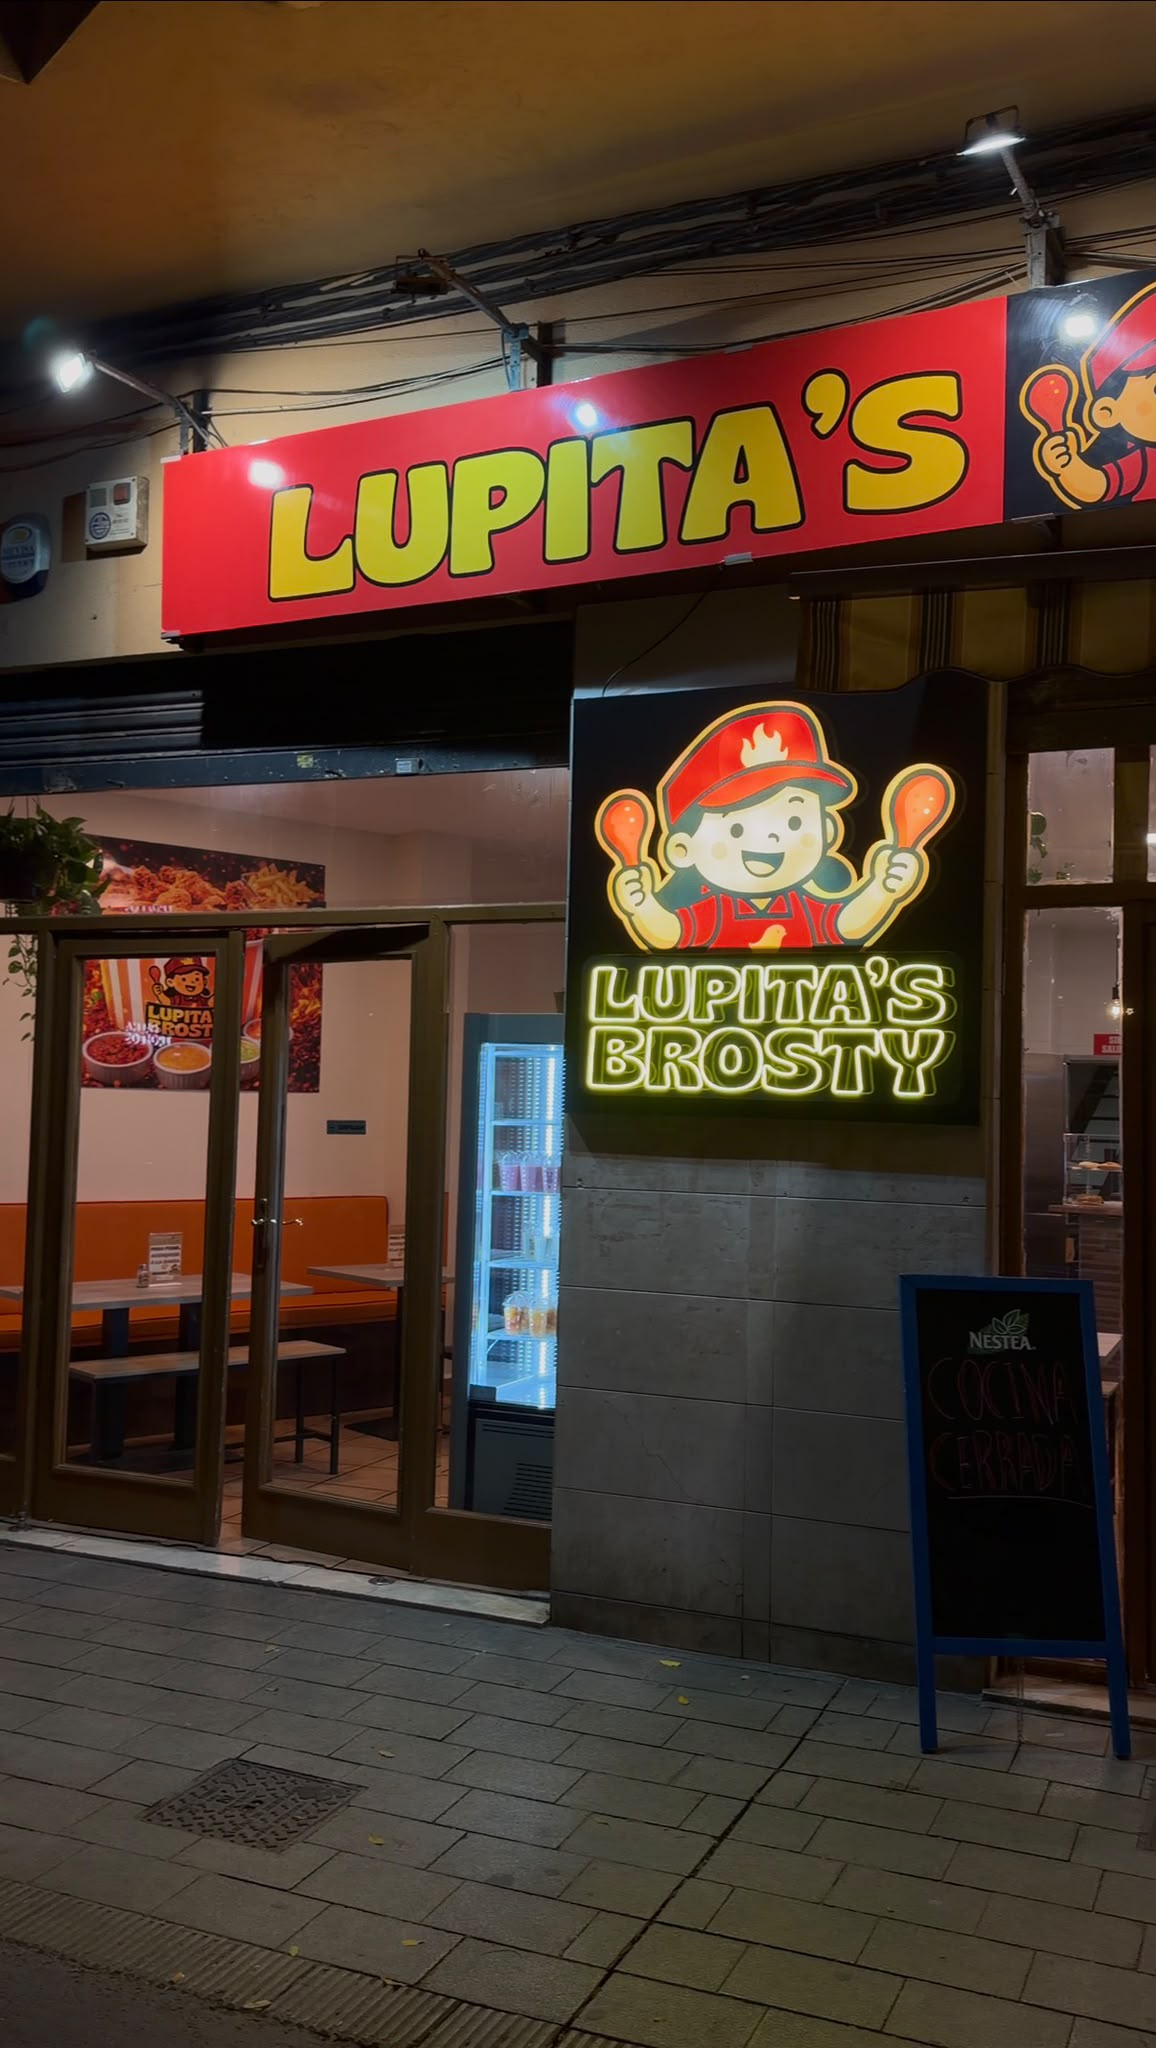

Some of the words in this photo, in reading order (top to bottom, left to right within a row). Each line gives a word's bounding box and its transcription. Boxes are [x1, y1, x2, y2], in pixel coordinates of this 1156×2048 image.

[268, 368, 969, 602] LUPITA'S
[148, 1005, 213, 1024] LUPITA
[589, 956, 948, 1025] LUPITA'S
[148, 1018, 213, 1037] BROST
[587, 1026, 947, 1097] BROSTY
[969, 1330, 1032, 1350] NESTEA
[928, 1357, 1079, 1424] COCINA
